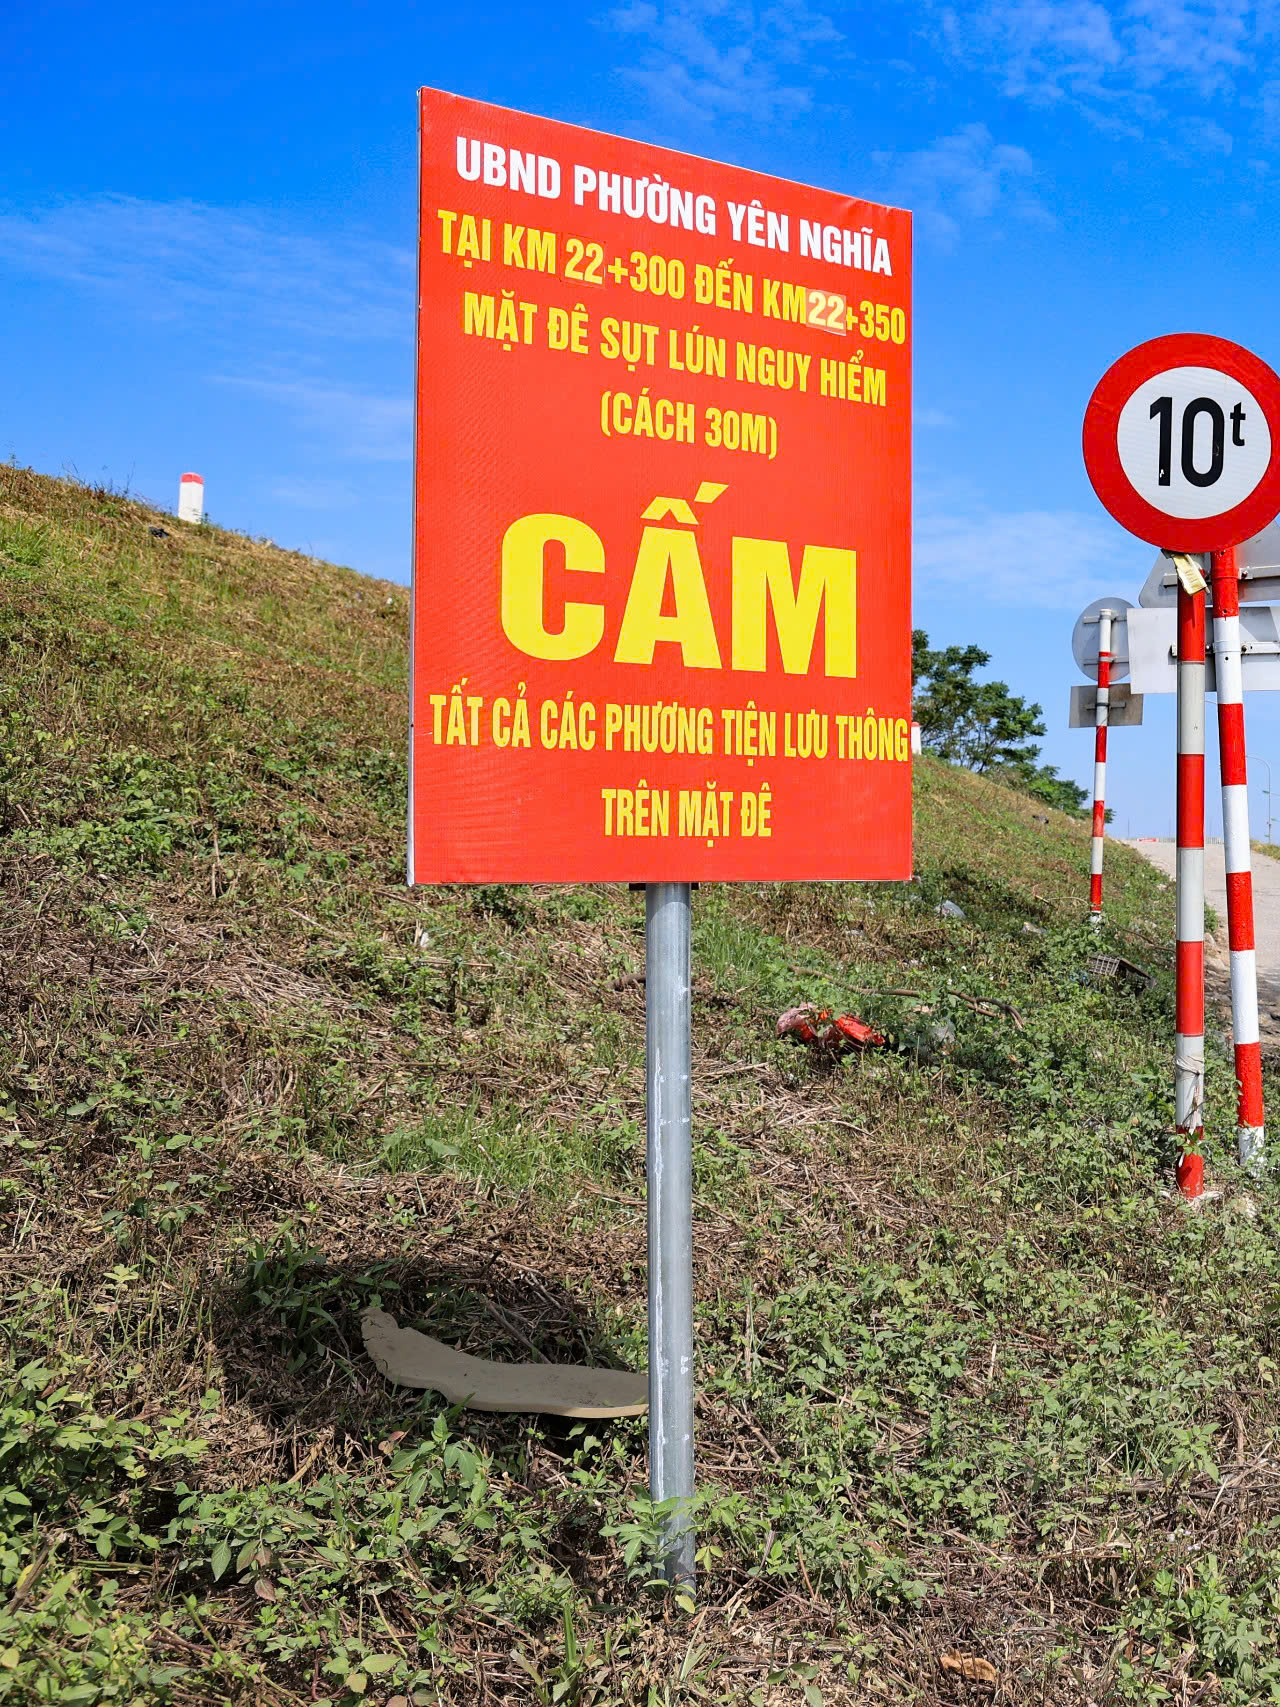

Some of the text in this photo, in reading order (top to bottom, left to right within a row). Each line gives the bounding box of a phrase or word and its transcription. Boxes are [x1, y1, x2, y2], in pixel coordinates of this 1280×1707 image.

[457, 135, 893, 277] UBND PHƯỜNG YÊN NGHĨA
[438, 209, 491, 269] TẠI
[503, 223, 557, 275] KM
[694, 257, 753, 314] ĐẾN
[463, 289, 887, 407] MẶT ĐÊ SỤT LÚN NGUY HIỂM
[601, 388, 777, 460] (CÁCH 30M)
[1149, 396, 1246, 488] 10t
[501, 481, 857, 679] CẤM
[430, 677, 908, 767] TẤT CẢ CÁC PHƯƠNG TIỆN LƯU THÔNG
[602, 779, 772, 848] TRÊN MẶT ĐÊ
